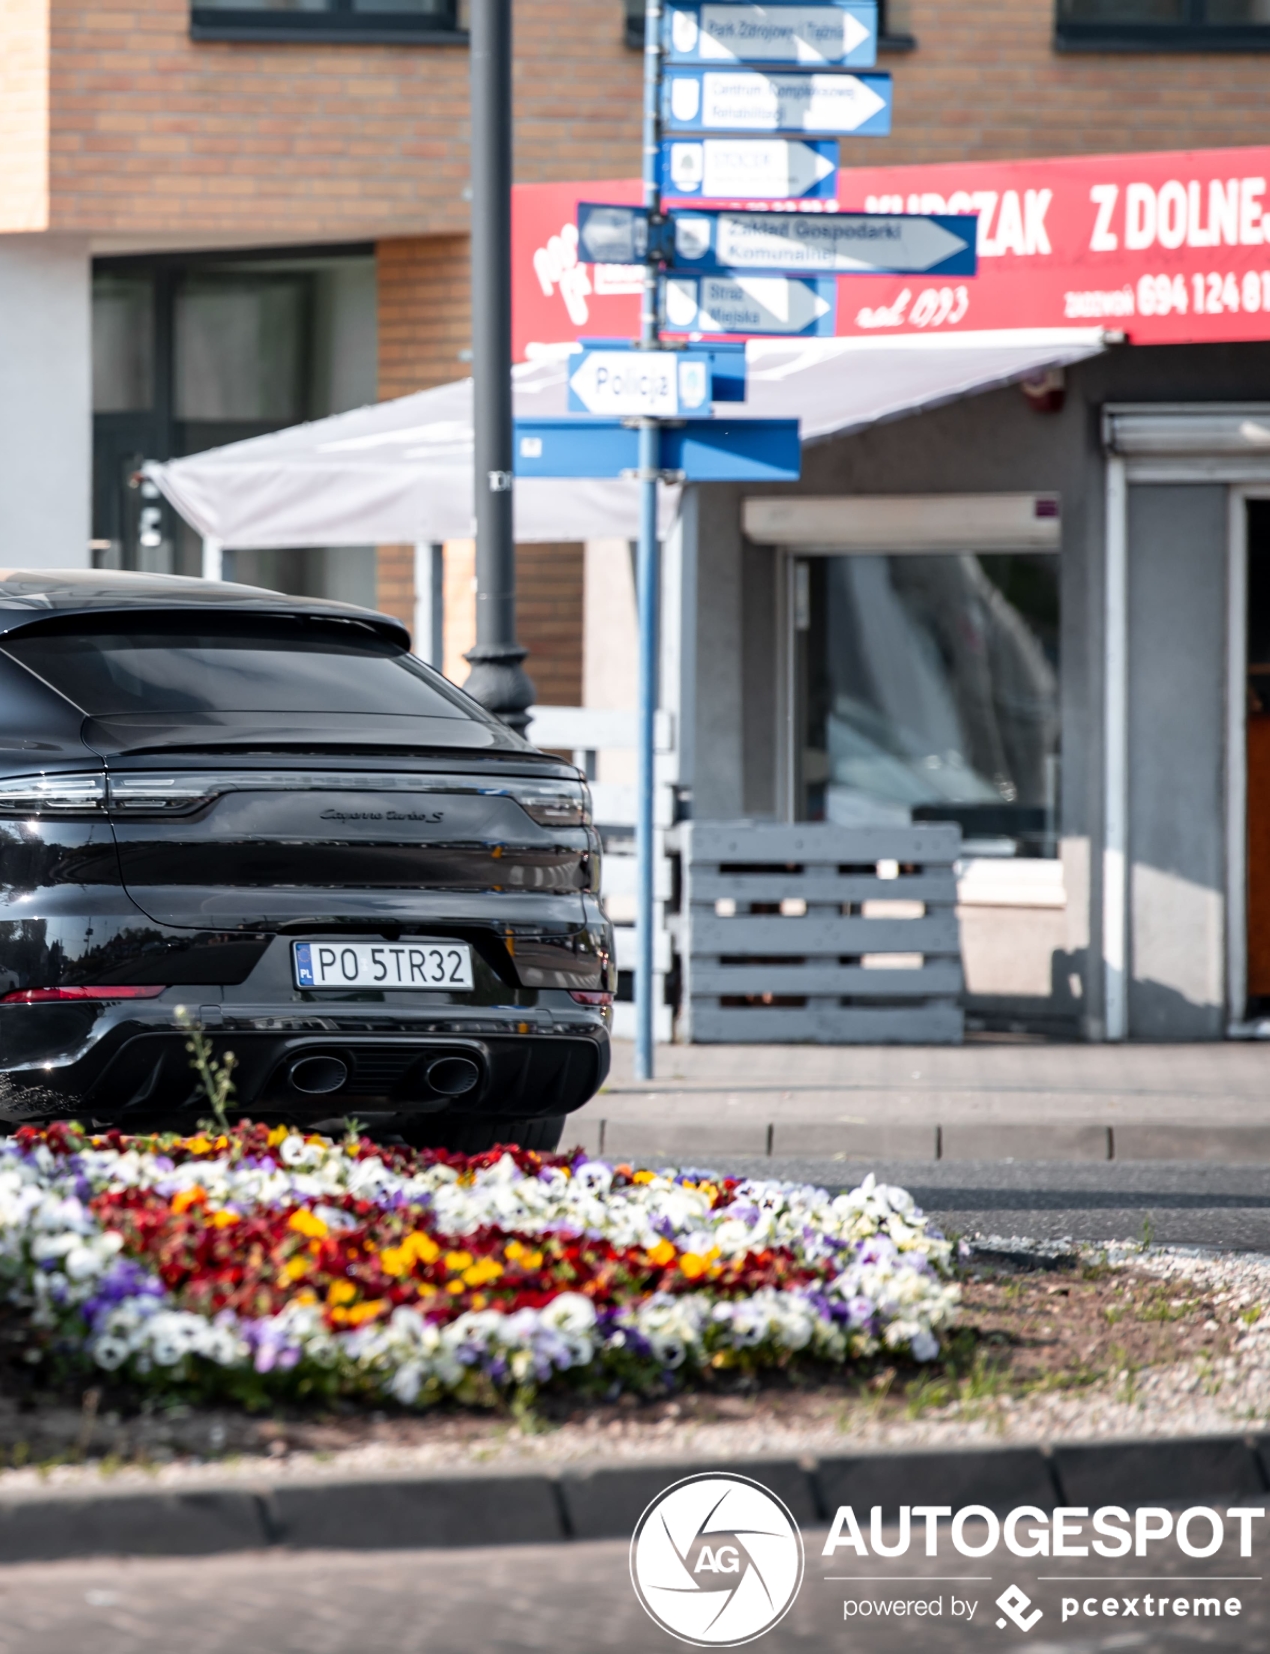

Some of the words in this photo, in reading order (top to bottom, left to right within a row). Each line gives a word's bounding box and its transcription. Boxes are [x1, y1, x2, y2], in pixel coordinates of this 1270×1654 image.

[729, 218, 789, 237] Zakład
[793, 218, 901, 241] Gospodarki
[1088, 184, 1119, 251] Z
[1125, 177, 1270, 250] DOLNE
[1192, 271, 1240, 314] 124
[710, 307, 761, 327] Miejska
[595, 366, 669, 404] Policja
[300, 968, 313, 979] PL
[318, 947, 359, 982] PO
[370, 947, 465, 983] 5TR32
